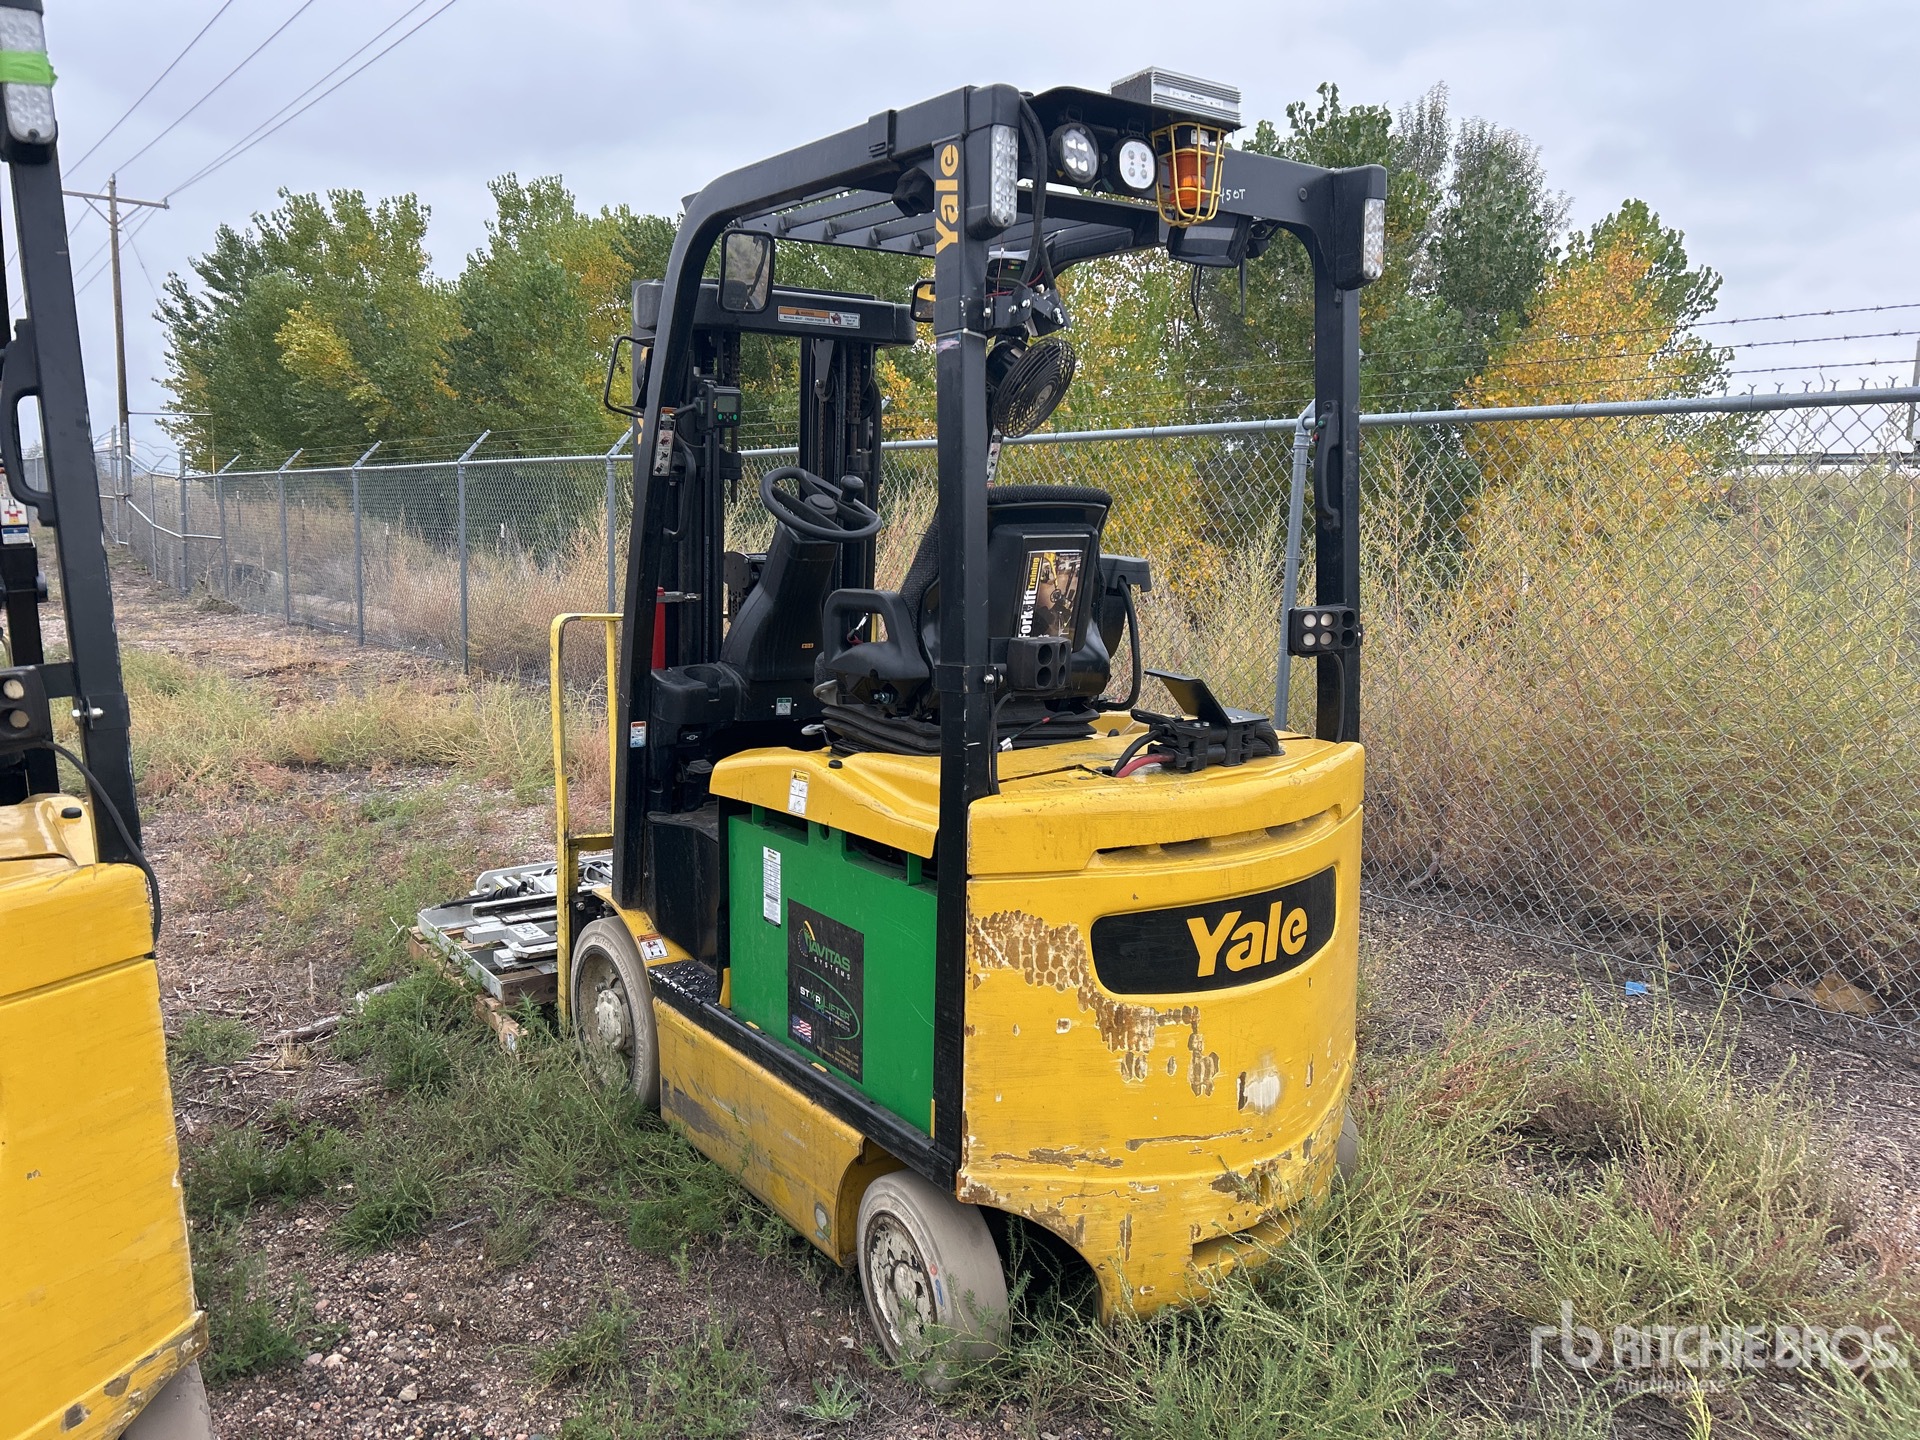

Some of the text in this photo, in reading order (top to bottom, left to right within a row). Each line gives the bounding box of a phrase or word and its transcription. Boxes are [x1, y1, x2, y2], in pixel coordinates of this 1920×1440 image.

[935, 144, 959, 254] Yale
[1028, 557, 1040, 589] Training
[1186, 900, 1308, 978] Yale
